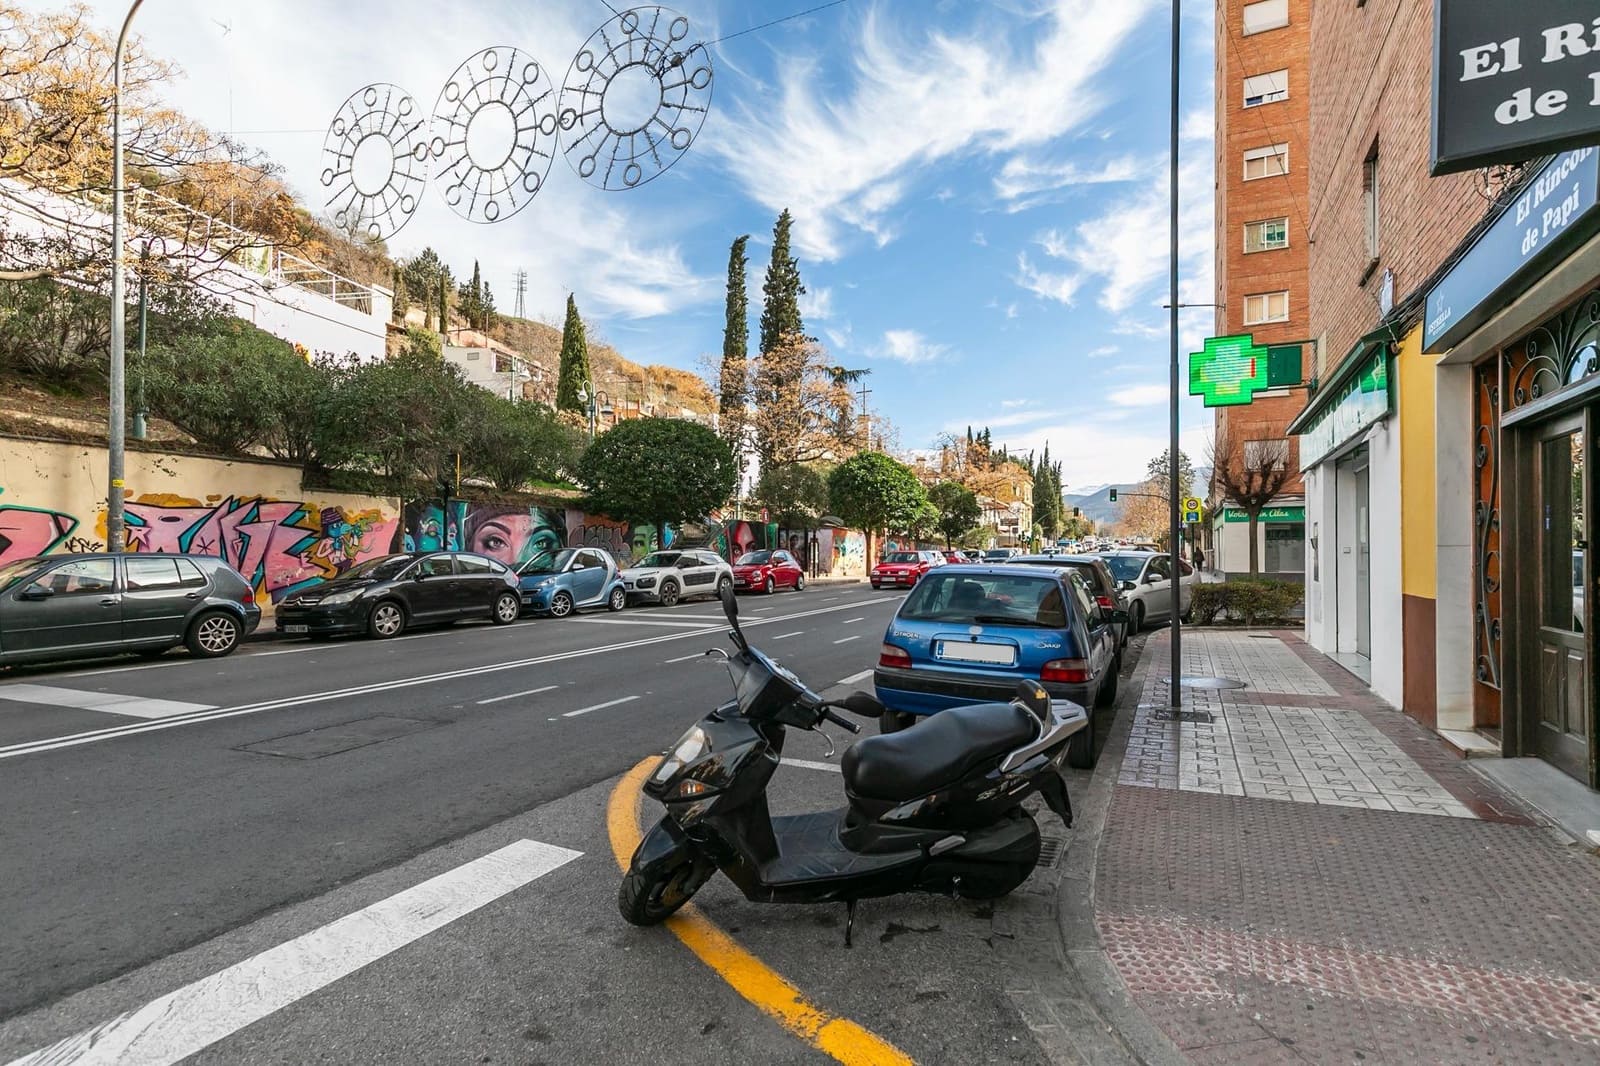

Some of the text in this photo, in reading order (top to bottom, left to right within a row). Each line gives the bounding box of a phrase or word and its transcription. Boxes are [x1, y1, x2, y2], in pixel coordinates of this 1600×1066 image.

[1459, 37, 1522, 82] El
[1494, 87, 1568, 125] de
[1516, 192, 1531, 226] El
[1521, 182, 1580, 255] de Papi
